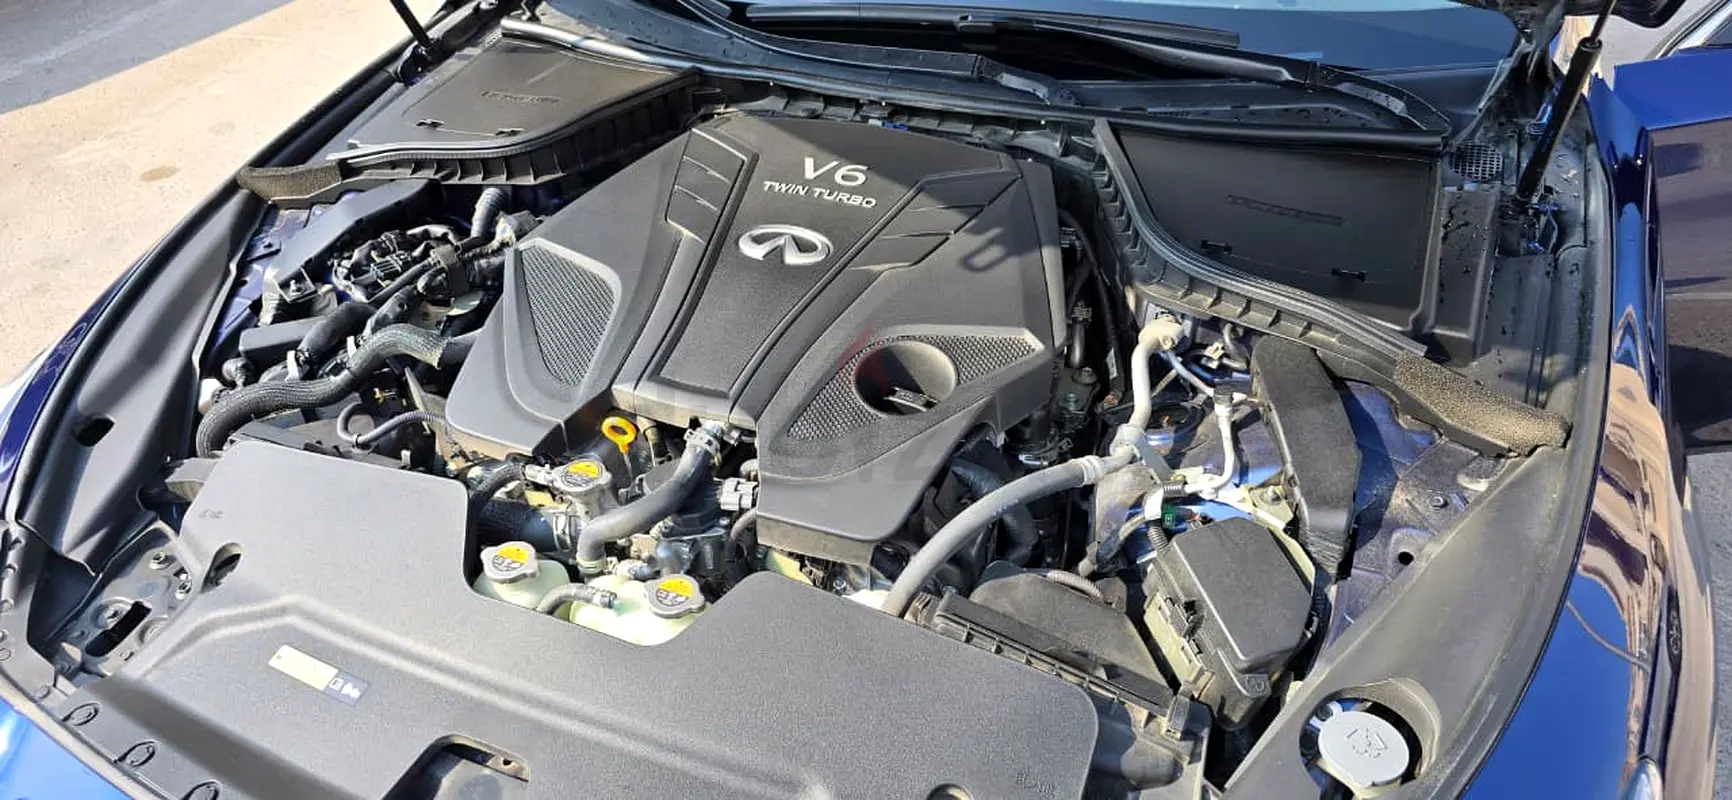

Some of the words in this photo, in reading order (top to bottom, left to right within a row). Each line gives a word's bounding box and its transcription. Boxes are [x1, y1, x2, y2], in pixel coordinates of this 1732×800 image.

[804, 156, 869, 187] V6
[763, 180, 809, 196] TWIN
[813, 186, 878, 208] TURBO
